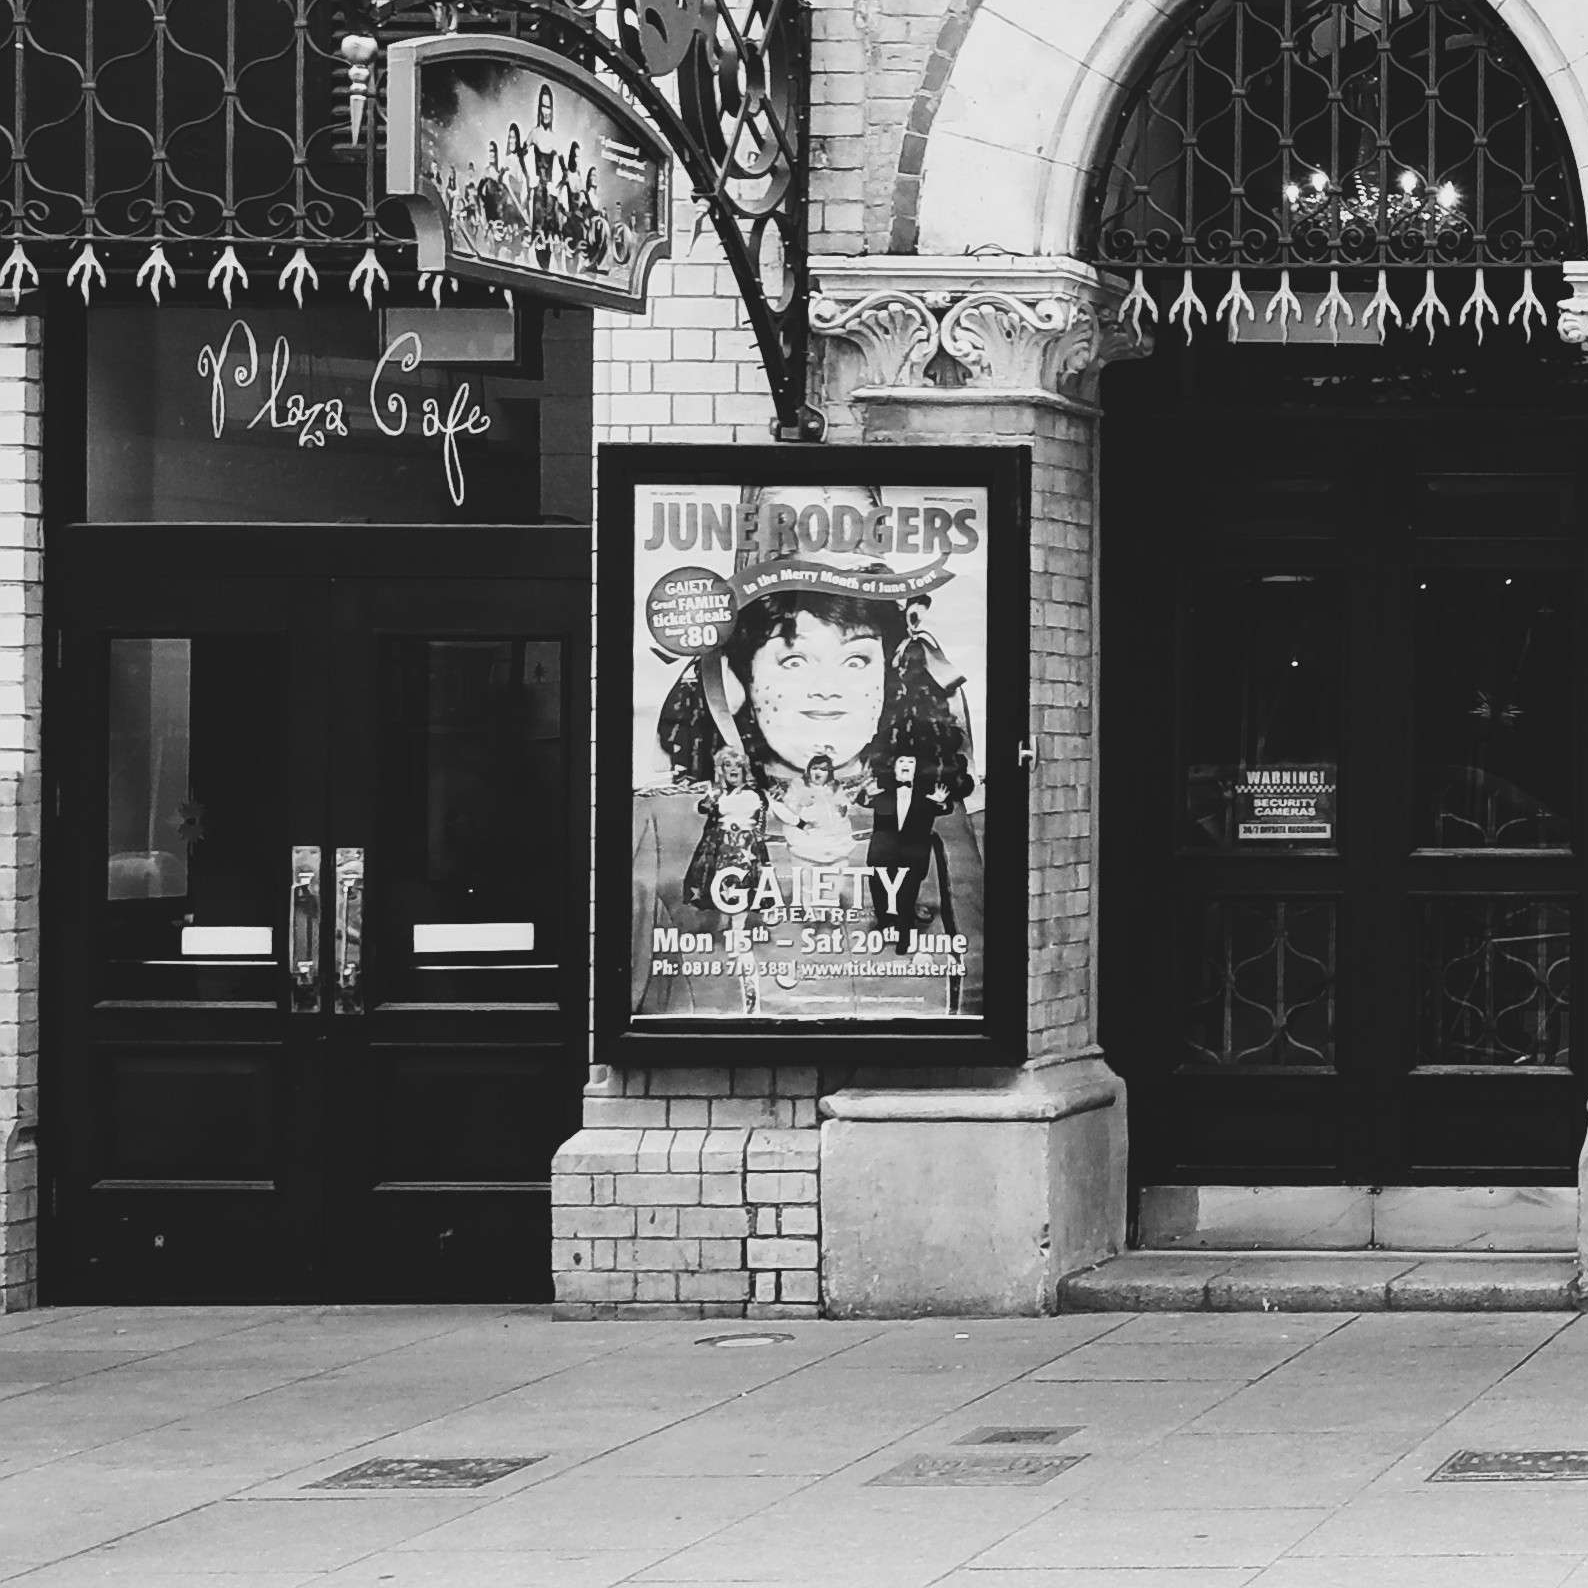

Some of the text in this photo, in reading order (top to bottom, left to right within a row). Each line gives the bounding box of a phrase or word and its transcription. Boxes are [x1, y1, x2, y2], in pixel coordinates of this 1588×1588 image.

[197, 319, 491, 506] Plaza Cafe
[643, 501, 980, 555] JUNE RODGERS
[665, 579, 714, 596] GAIETY
[743, 568, 937, 595] In the Merry Month of June Tour
[678, 594, 731, 611] FAMILY
[653, 608, 732, 627] ticket deals
[680, 624, 718, 647] €80
[1246, 770, 1325, 785] WARNING!
[1253, 798, 1317, 807] SECURITY
[1254, 807, 1316, 817] CAMERAS
[709, 865, 911, 915] GAIETY
[759, 907, 859, 923] THEATRE
[652, 927, 713, 953] Mon
[724, 925, 769, 954] 15th
[800, 928, 844, 954] Sat
[851, 925, 900, 954] 20th
[907, 928, 968, 954] June
[652, 960, 679, 976] Ph:
[681, 960, 722, 976] 0818
[726, 960, 755, 976] 719
[759, 960, 787, 976] 388
[801, 960, 967, 977] www.ticketmaster.ie
